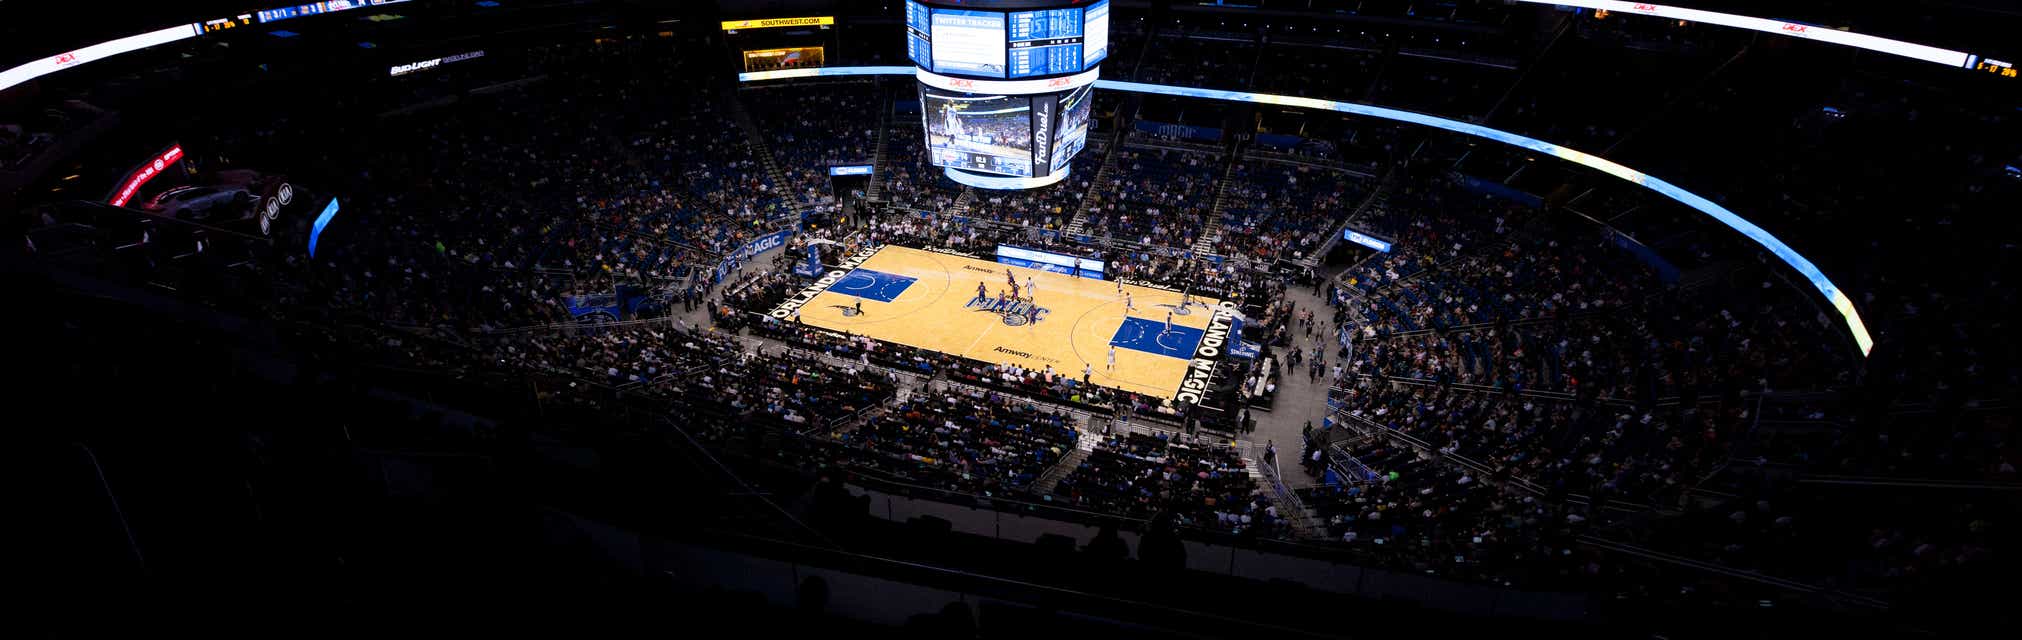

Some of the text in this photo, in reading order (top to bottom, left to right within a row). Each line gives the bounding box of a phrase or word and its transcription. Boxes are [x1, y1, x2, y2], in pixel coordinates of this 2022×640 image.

[761, 18, 820, 26] SOUTHWEST.COM
[1782, 23, 1807, 33] DEX
[54, 52, 75, 64] DEX
[412, 58, 442, 70] LIGHT
[950, 79, 973, 87] DEX
[1048, 77, 1071, 87] DEX
[771, 270, 846, 319] ORLANDO
[1199, 301, 1239, 357] ORLANDO
[993, 346, 1032, 359] Amway
[1178, 358, 1214, 404] MAGIC
